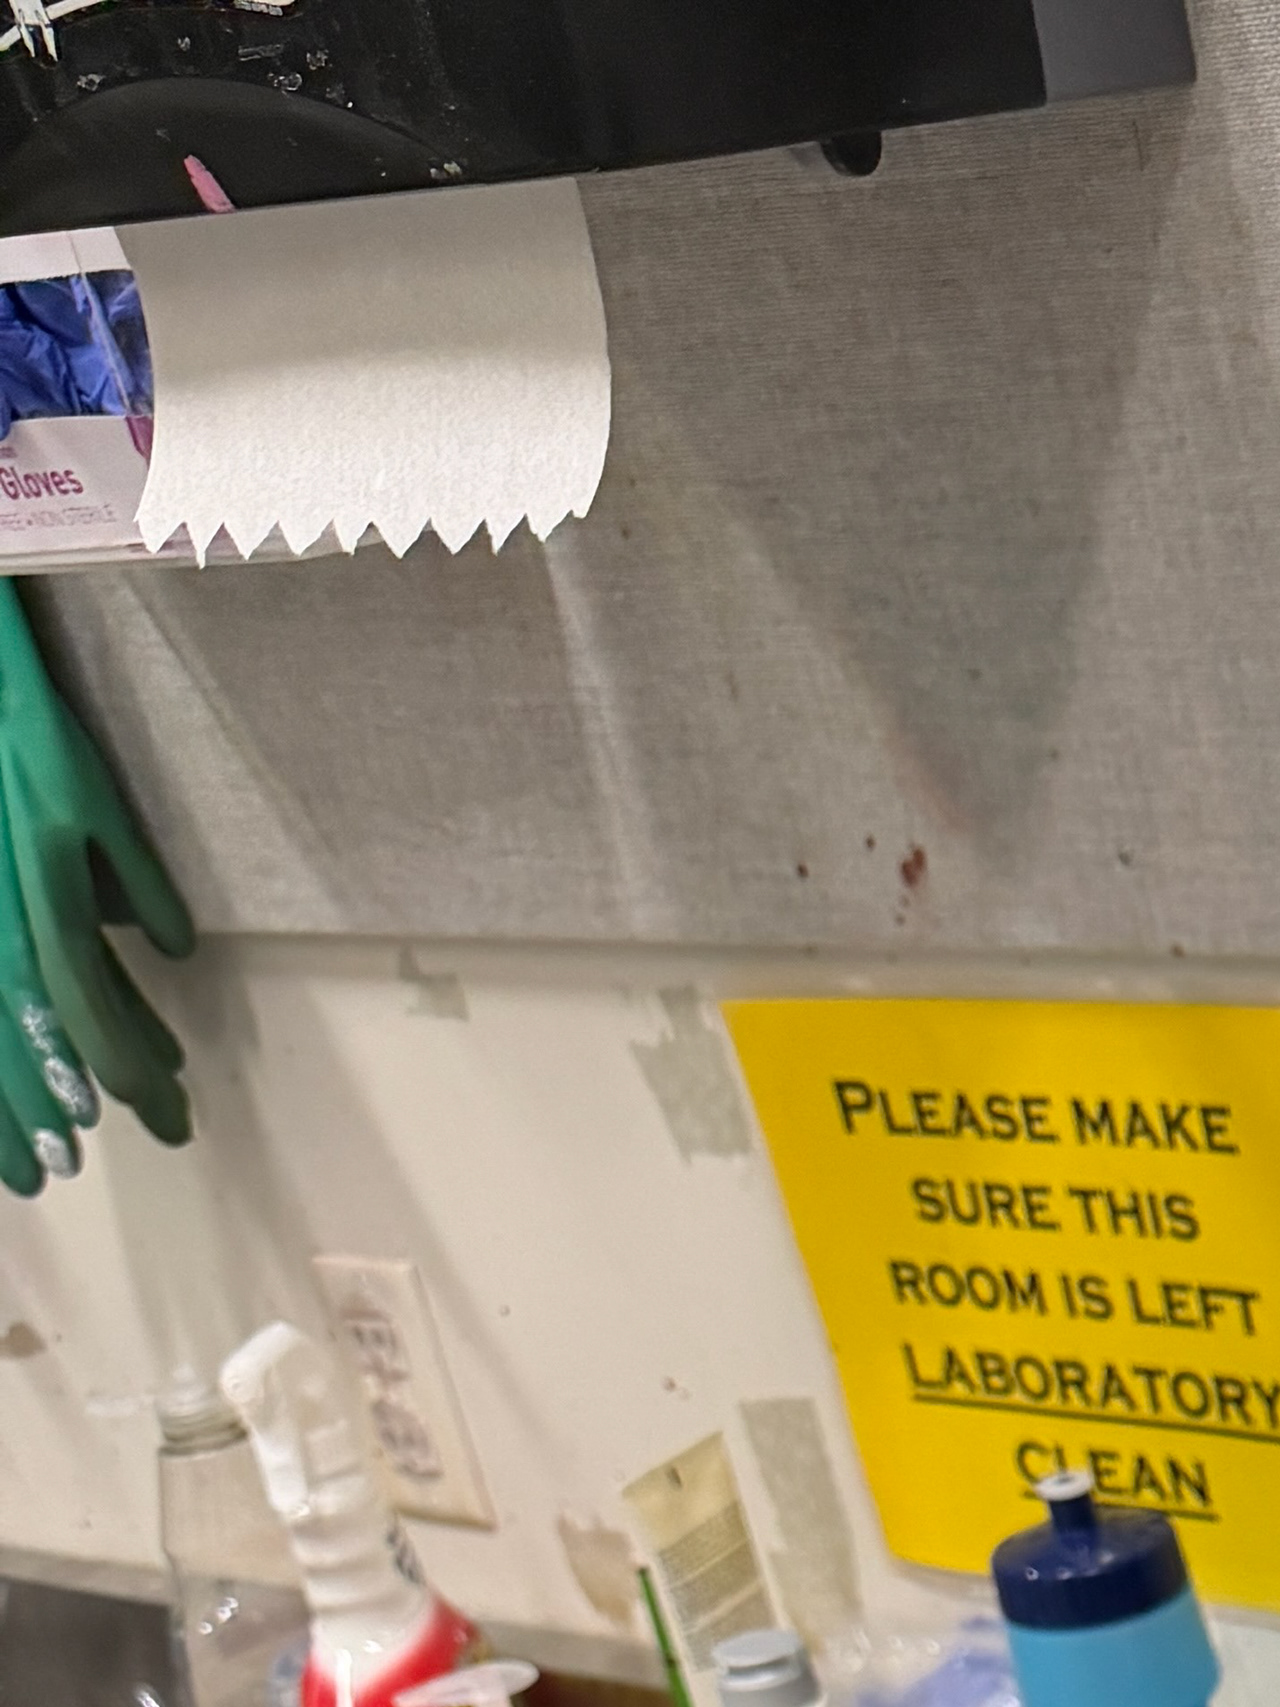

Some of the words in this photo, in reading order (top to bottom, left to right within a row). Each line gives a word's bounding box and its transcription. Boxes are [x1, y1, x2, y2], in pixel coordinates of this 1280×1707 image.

[0, 466, 84, 499] Gloves
[832, 1078, 1059, 1142] PLEASE
[1072, 1097, 1241, 1155] MAKE
[911, 1177, 1062, 1232] SURE
[1069, 1187, 1201, 1242] THIS
[889, 1259, 1049, 1316] ROOM
[1060, 1274, 1116, 1321] IS
[1129, 1279, 1261, 1337] LEFT
